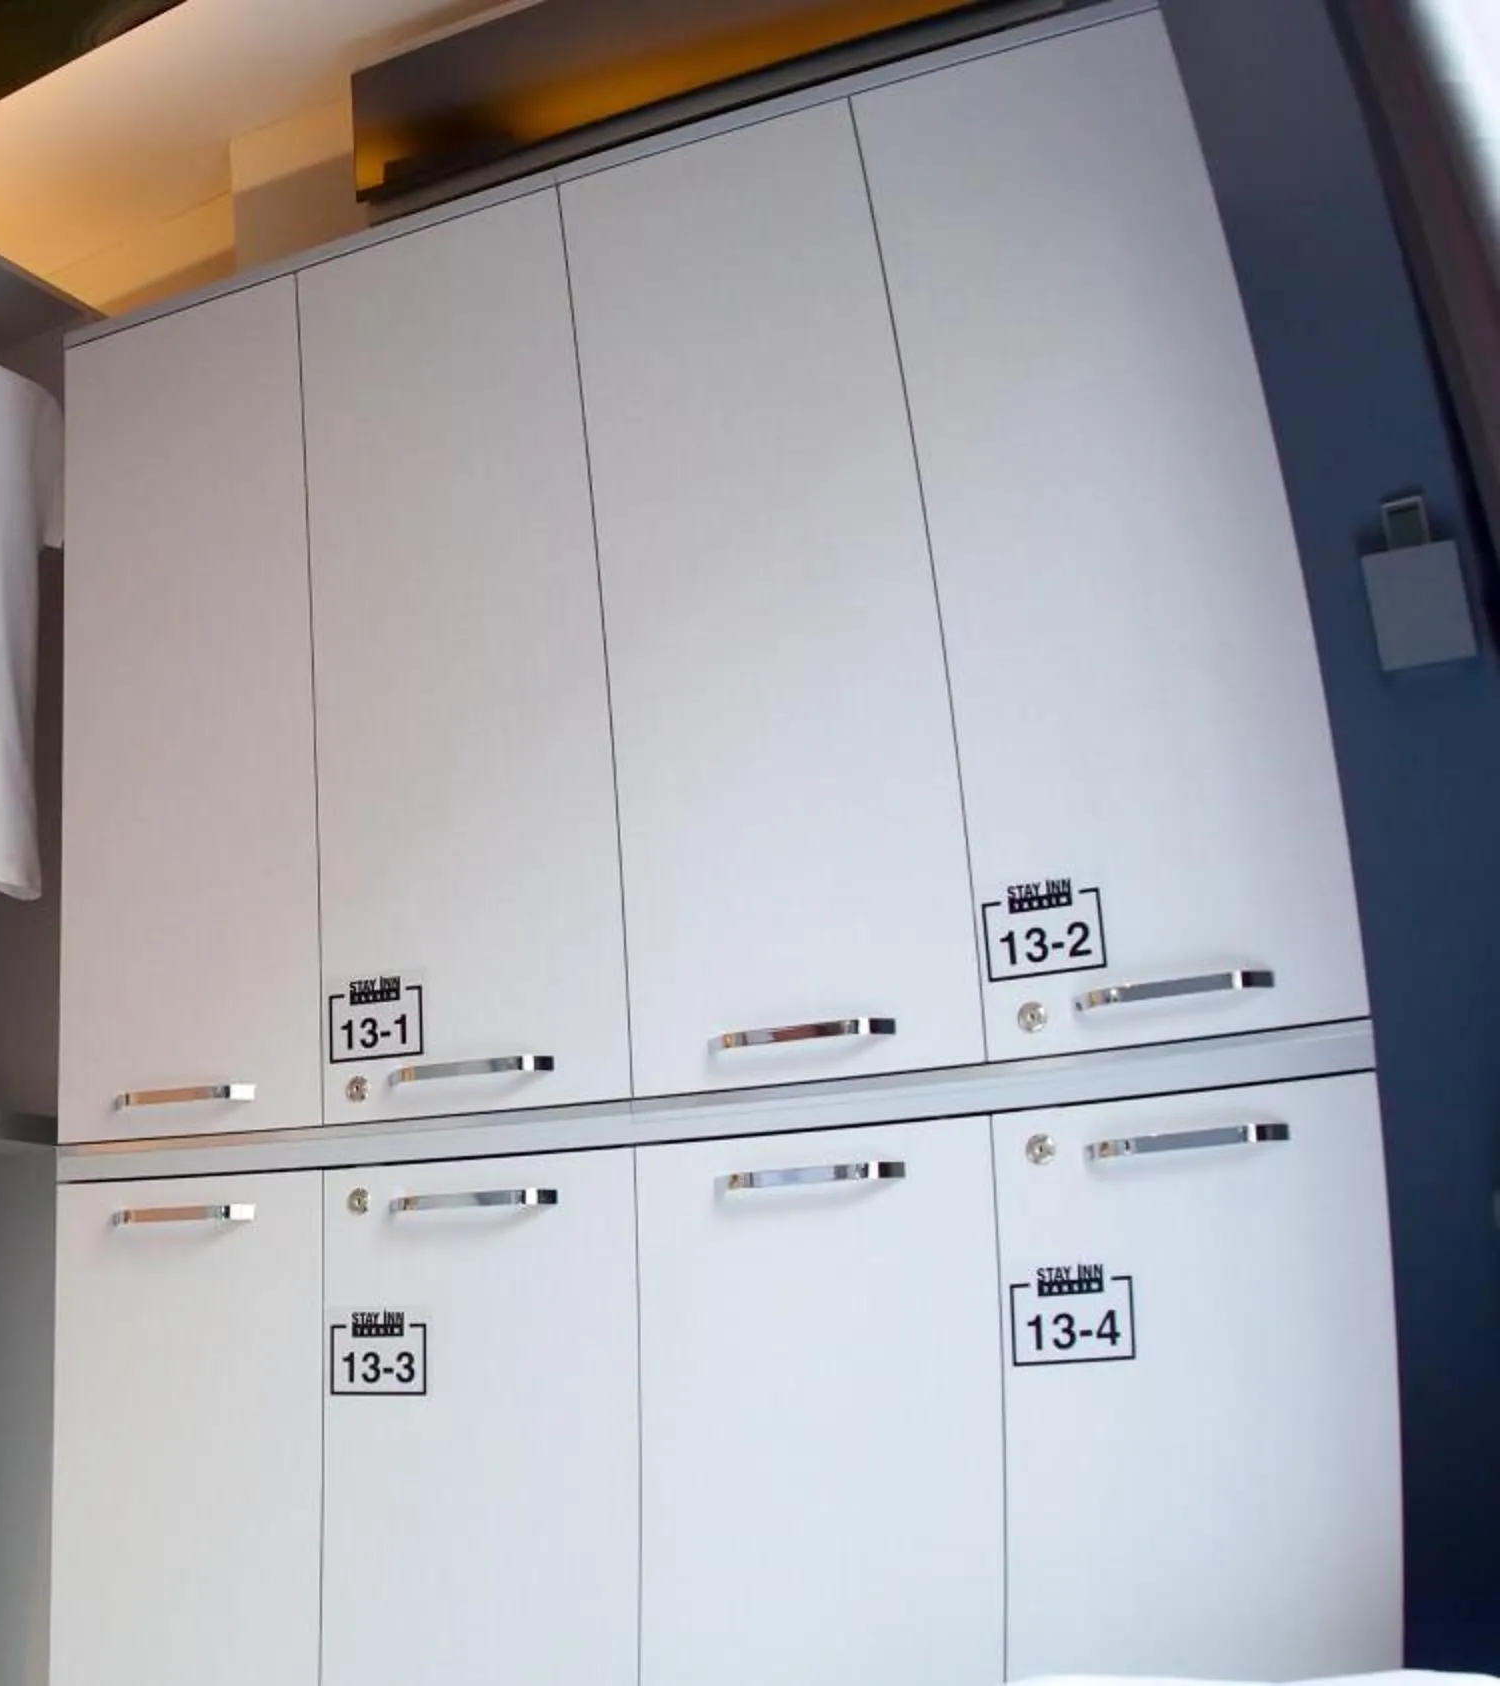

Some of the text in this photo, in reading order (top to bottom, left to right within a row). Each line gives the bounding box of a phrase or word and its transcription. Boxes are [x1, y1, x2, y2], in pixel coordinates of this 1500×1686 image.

[1007, 880, 1041, 899] STAY
[1000, 921, 1092, 965] 13-2
[349, 979, 376, 993] STAY
[340, 1014, 407, 1050] 13-1
[1036, 1266, 1071, 1282] STAY
[351, 1311, 380, 1325] STAY
[1027, 1309, 1121, 1351] 13-4
[342, 1351, 416, 1383] 13-3
